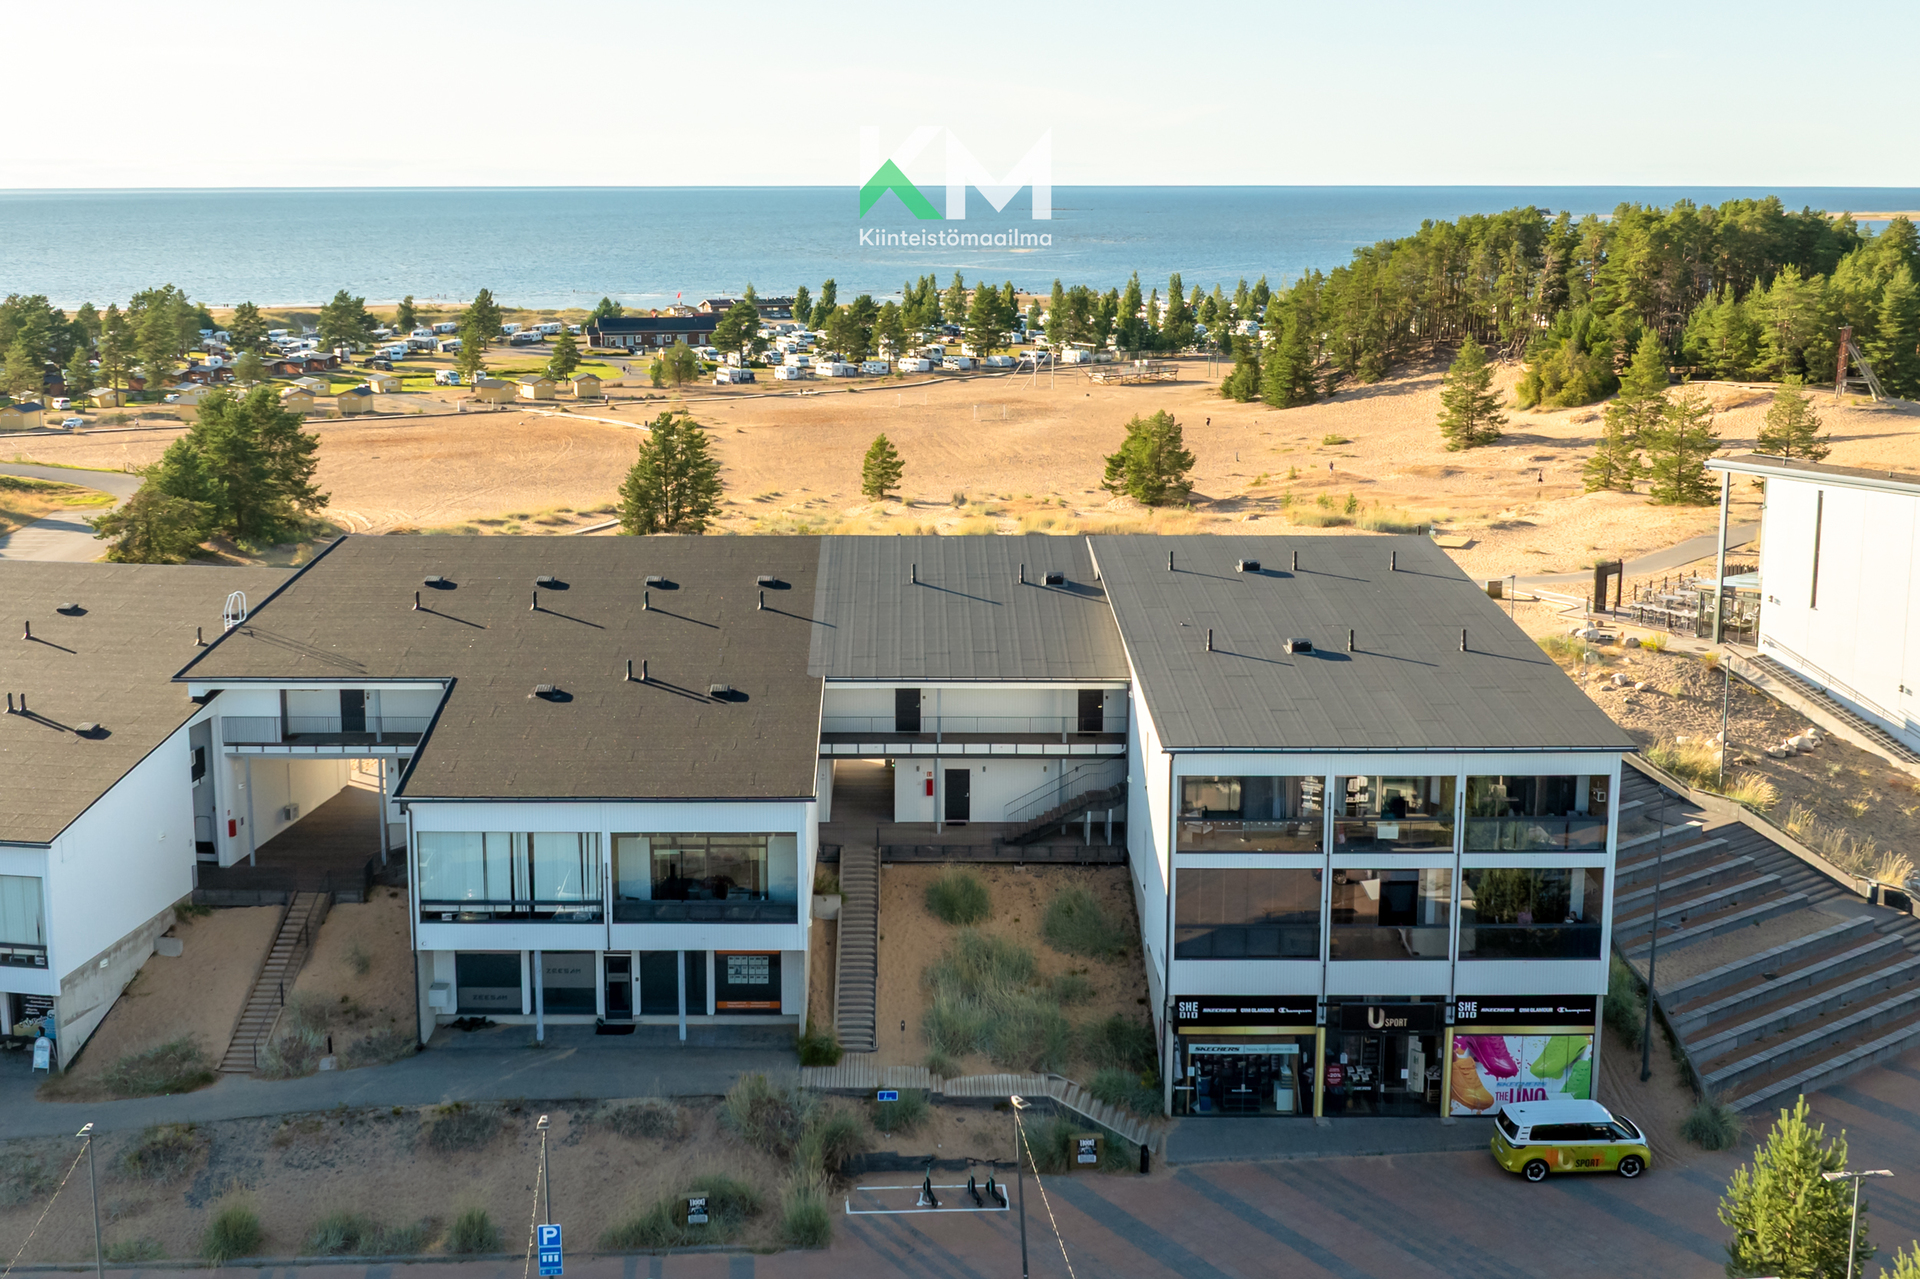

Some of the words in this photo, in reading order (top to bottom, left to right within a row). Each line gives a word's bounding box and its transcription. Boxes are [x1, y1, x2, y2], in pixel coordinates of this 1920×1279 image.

[1179, 1001, 1198, 1012] SHE
[1458, 1001, 1477, 1012] SHE
[1368, 1006, 1385, 1029] U
[1385, 1018, 1408, 1027] SPORT
[1495, 1091, 1509, 1101] THE
[1575, 1158, 1600, 1168] SPORT
[542, 1227, 558, 1245] P
